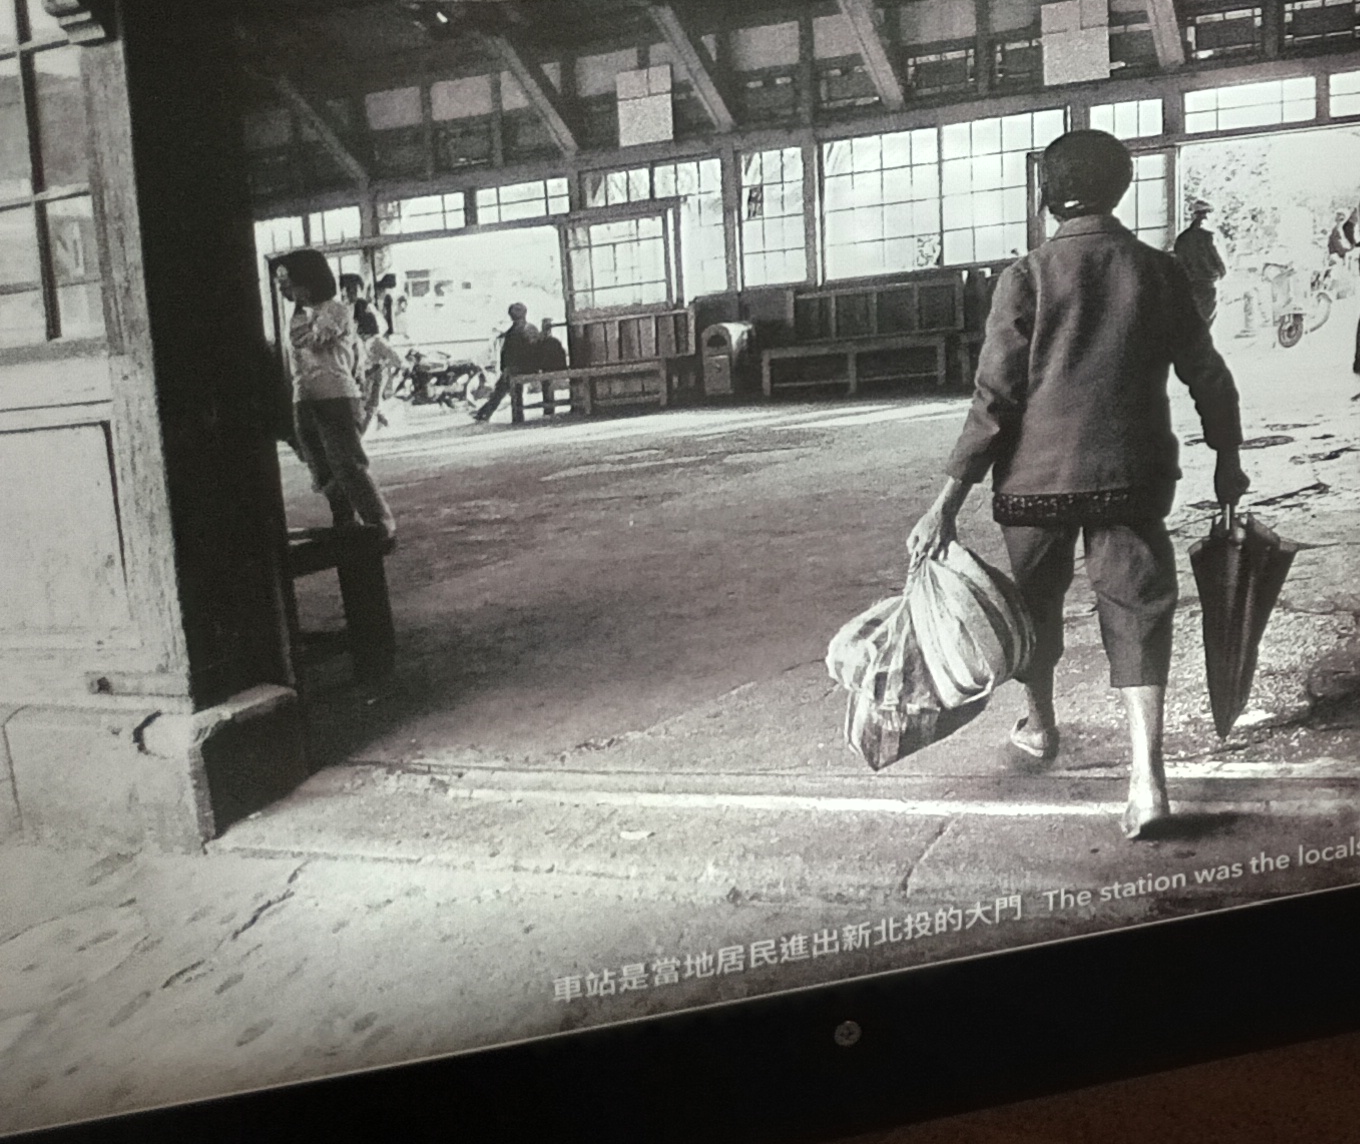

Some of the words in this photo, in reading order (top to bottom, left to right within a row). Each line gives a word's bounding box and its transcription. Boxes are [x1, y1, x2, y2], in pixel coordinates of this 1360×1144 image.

[551, 893, 1024, 1005] 車站是當地居民進出新北投的大門
[1042, 887, 1093, 912] The
[1100, 871, 1188, 904] station
[1194, 861, 1244, 885] was
[1250, 851, 1291, 875] the
